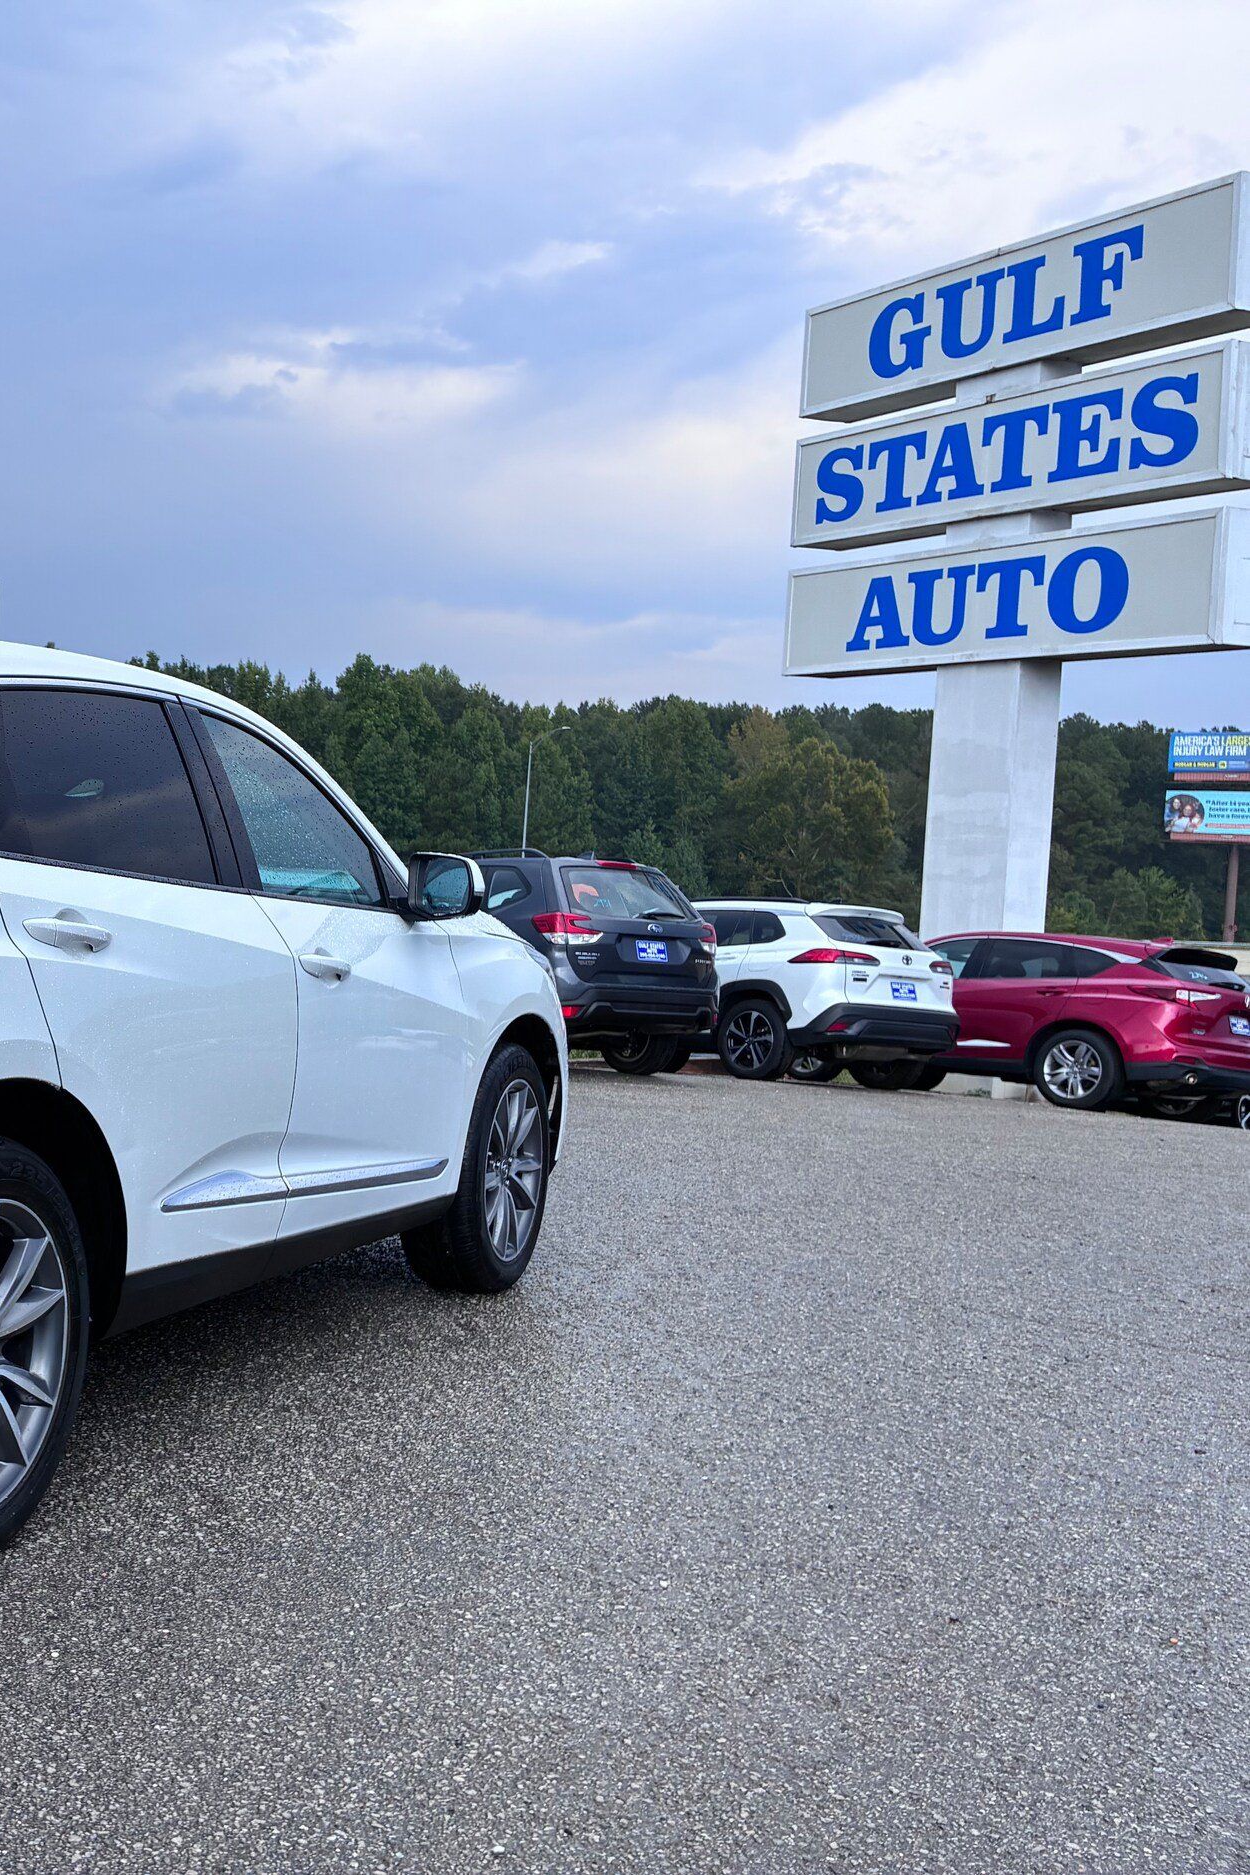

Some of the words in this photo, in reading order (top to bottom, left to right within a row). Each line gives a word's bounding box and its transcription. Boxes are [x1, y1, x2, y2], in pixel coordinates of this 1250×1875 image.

[868, 224, 1145, 379] GULF
[814, 372, 1200, 526] STATES
[845, 545, 1130, 653] AUTO
[1173, 745, 1203, 756] INJURY
[1204, 745, 1224, 756] LAW
[1225, 746, 1247, 756] FIRM
[1174, 735, 1220, 746] AMERICA'S
